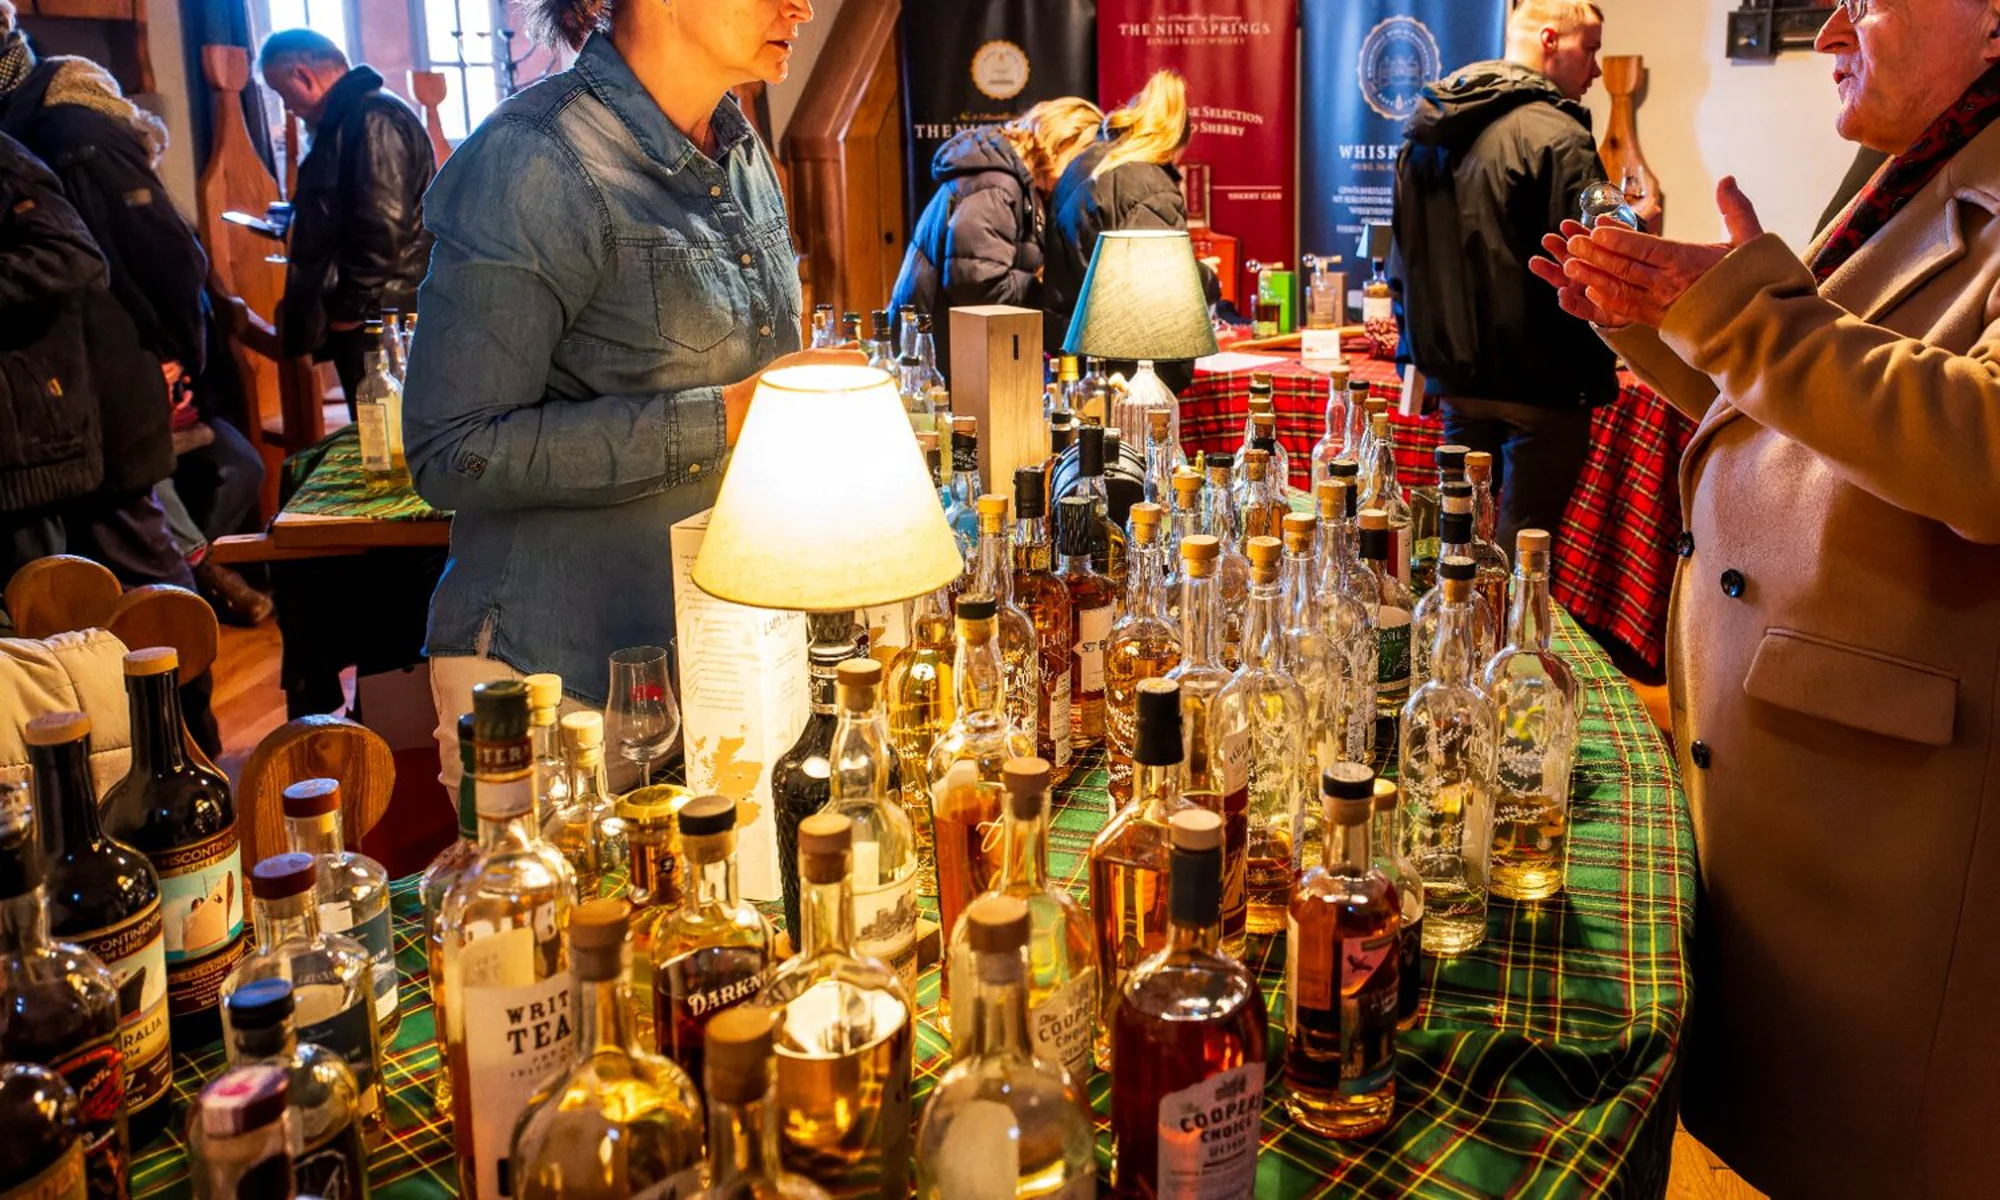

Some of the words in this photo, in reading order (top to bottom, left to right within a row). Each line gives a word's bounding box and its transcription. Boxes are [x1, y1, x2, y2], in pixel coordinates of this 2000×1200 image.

[1118, 23, 1150, 36] THE
[1155, 23, 1196, 36] NINE
[1200, 21, 1271, 36] SPRINGS
[1201, 105, 1264, 125] SELECTION
[914, 123, 952, 139] THE
[1200, 120, 1246, 137] SHERRY
[505, 989, 570, 1026] WRIT
[506, 1012, 572, 1056] TEA
